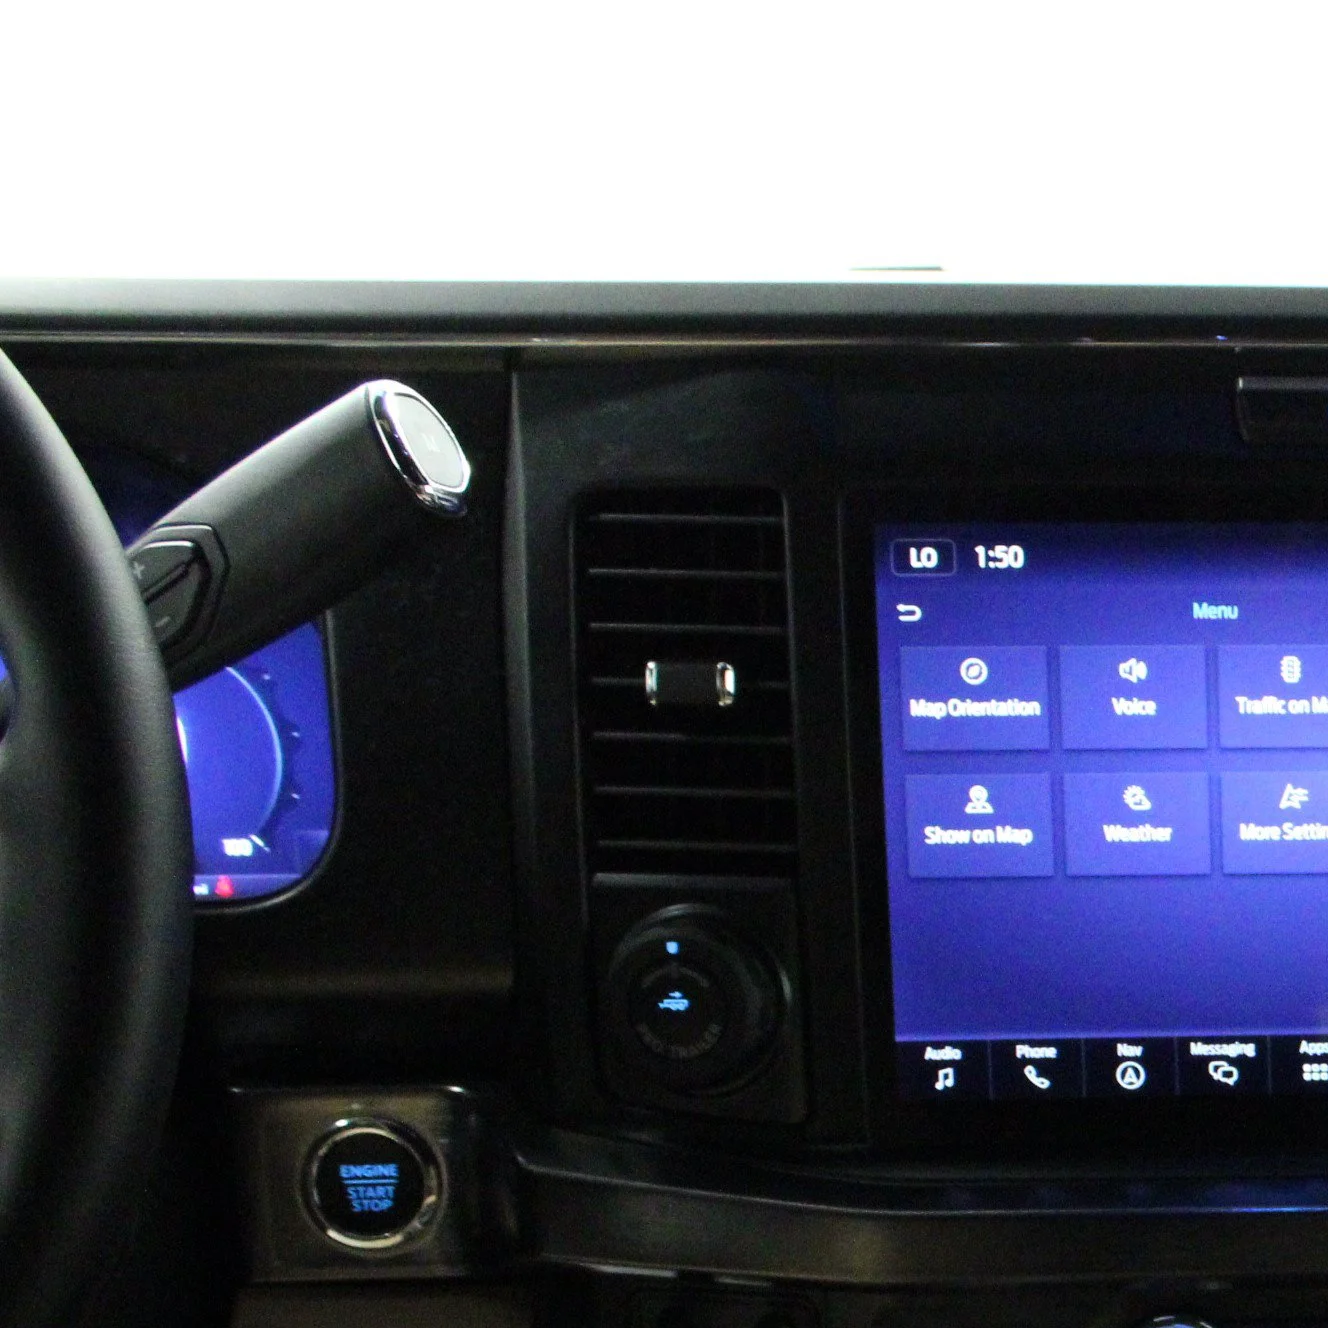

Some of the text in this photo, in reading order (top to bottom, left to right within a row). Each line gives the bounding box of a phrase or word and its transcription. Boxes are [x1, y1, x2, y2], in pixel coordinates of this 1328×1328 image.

[909, 546, 939, 569] LO
[974, 544, 1025, 569] 1:50
[1192, 602, 1239, 620] Menu
[909, 698, 1042, 720] Map Orientation
[1111, 697, 1157, 716] Voice
[1234, 695, 1287, 715] Traffic
[1287, 699, 1311, 715] on
[924, 825, 1034, 846] Show on Map
[1102, 823, 1173, 843] Weather
[1239, 822, 1282, 841] More
[924, 1045, 962, 1061] Audio
[1015, 1044, 1058, 1059] Phone
[1116, 1043, 1143, 1057] Nav
[1189, 1041, 1256, 1058] Messaging
[340, 1163, 397, 1178] ENGINE
[347, 1185, 395, 1200] START
[351, 1199, 393, 1212] STOP
